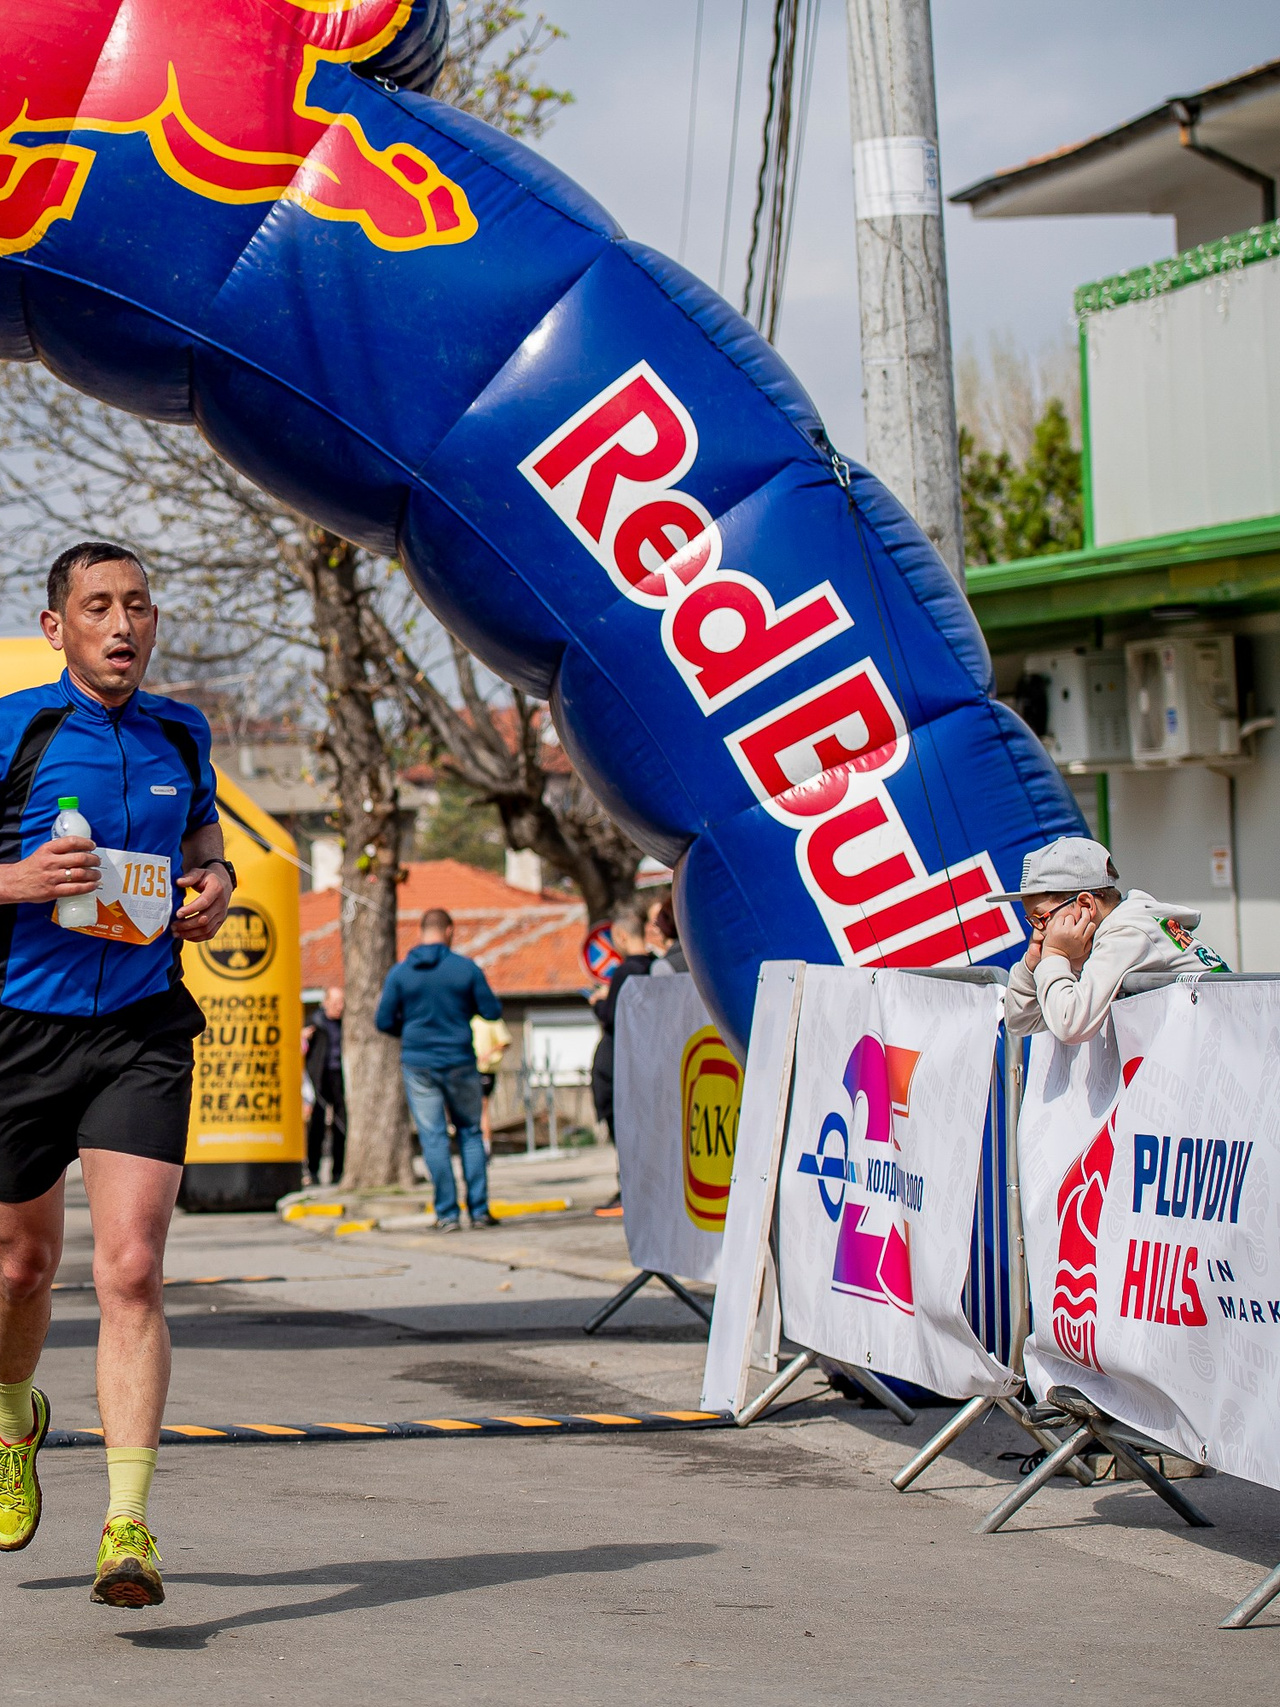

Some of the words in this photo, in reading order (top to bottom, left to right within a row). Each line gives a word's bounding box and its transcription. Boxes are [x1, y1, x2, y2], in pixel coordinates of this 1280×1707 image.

[524, 366, 846, 708] Red
[730, 660, 1018, 970] Bull
[122, 861, 167, 898] 1135
[199, 995, 279, 1011] CHOOSE
[200, 1026, 281, 1046] BUILD
[200, 1062, 279, 1078] DEFINE
[200, 1092, 281, 1110] REACH
[1132, 1133, 1254, 1224] PLOVDIV
[1120, 1238, 1208, 1327] HILLS
[1207, 1259, 1235, 1283] IN
[1217, 1295, 1280, 1323] MARK
